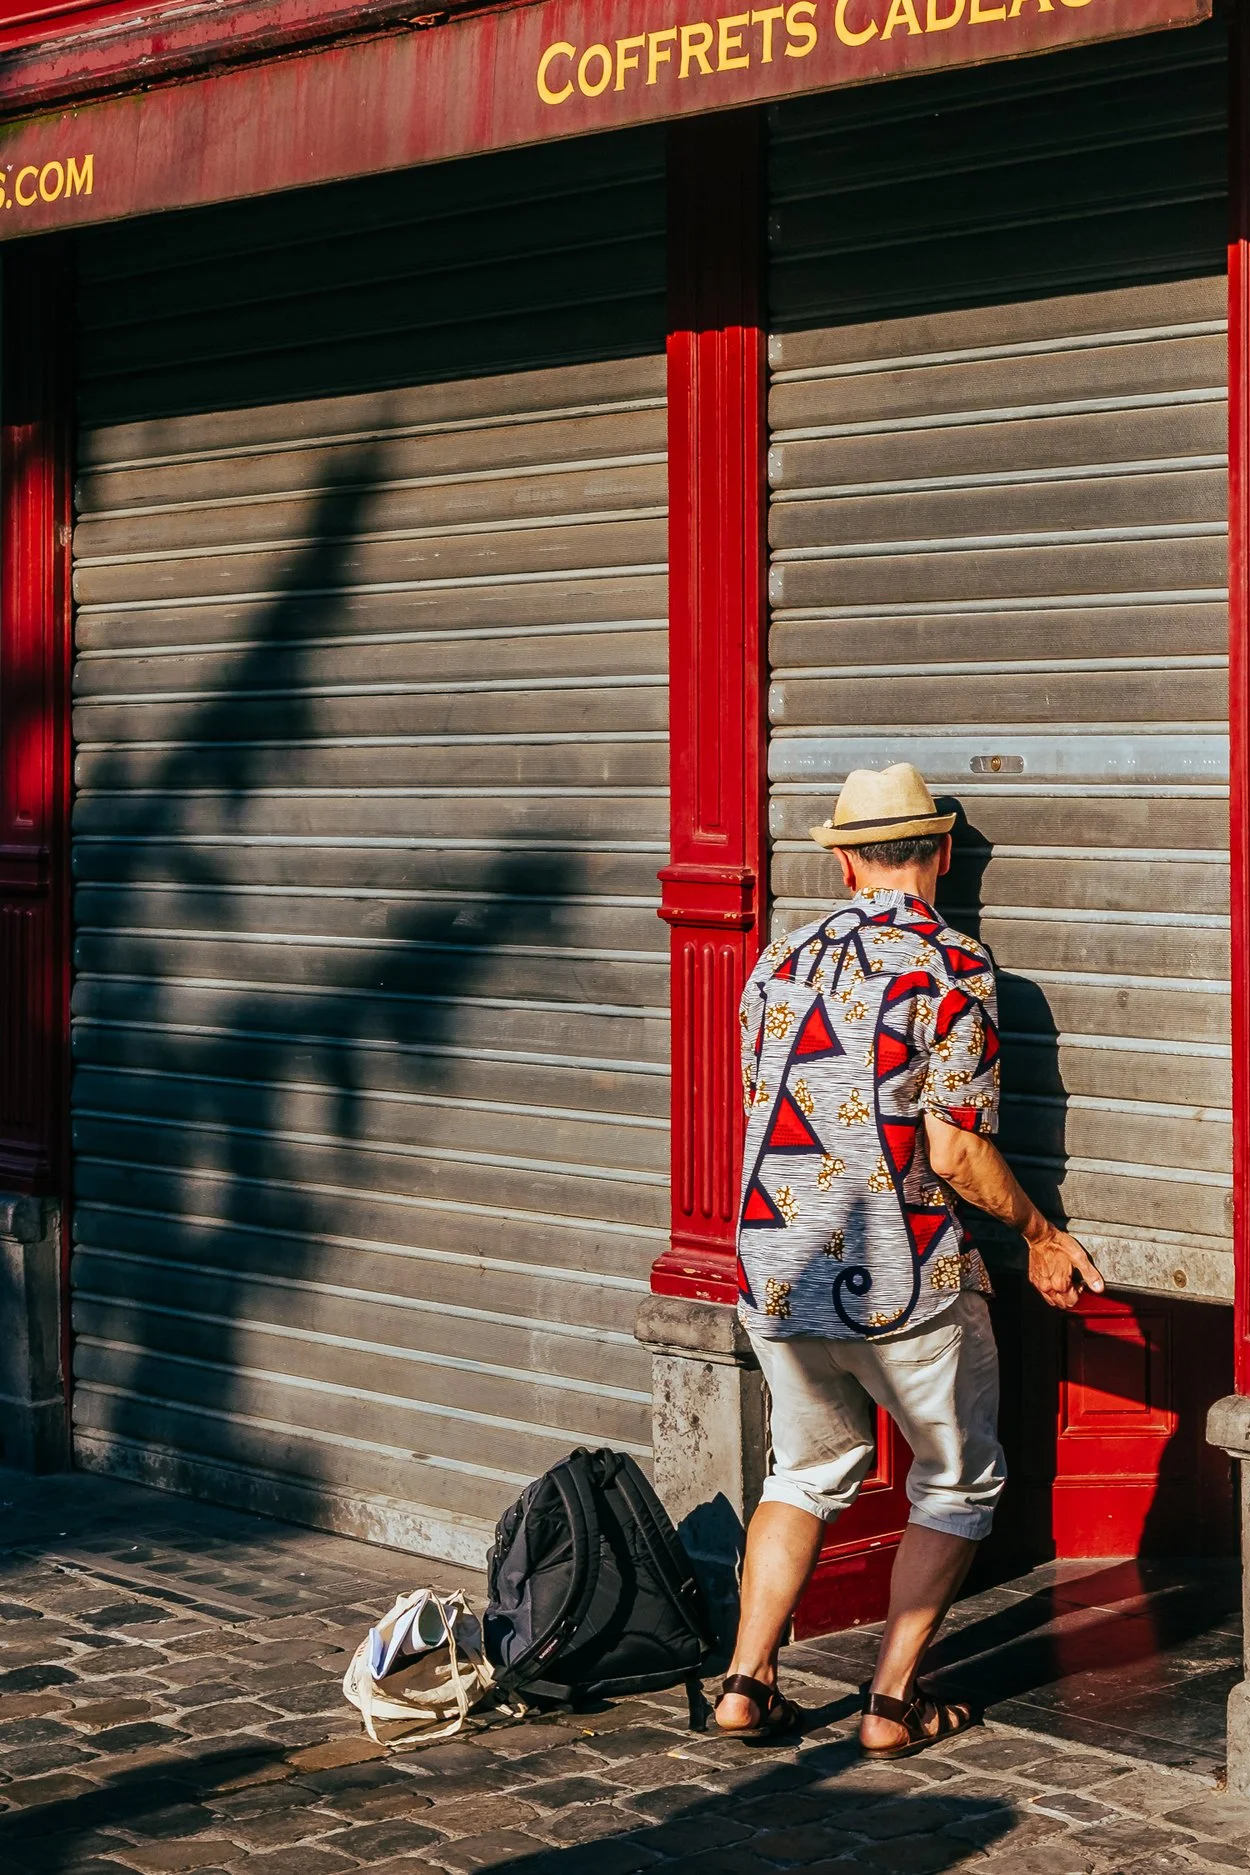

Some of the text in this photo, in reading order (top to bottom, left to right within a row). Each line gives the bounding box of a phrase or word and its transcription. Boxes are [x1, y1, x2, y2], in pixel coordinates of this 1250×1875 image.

[536, 0, 1093, 105] COFFRETS CAD
[0, 153, 95, 209] .COM
